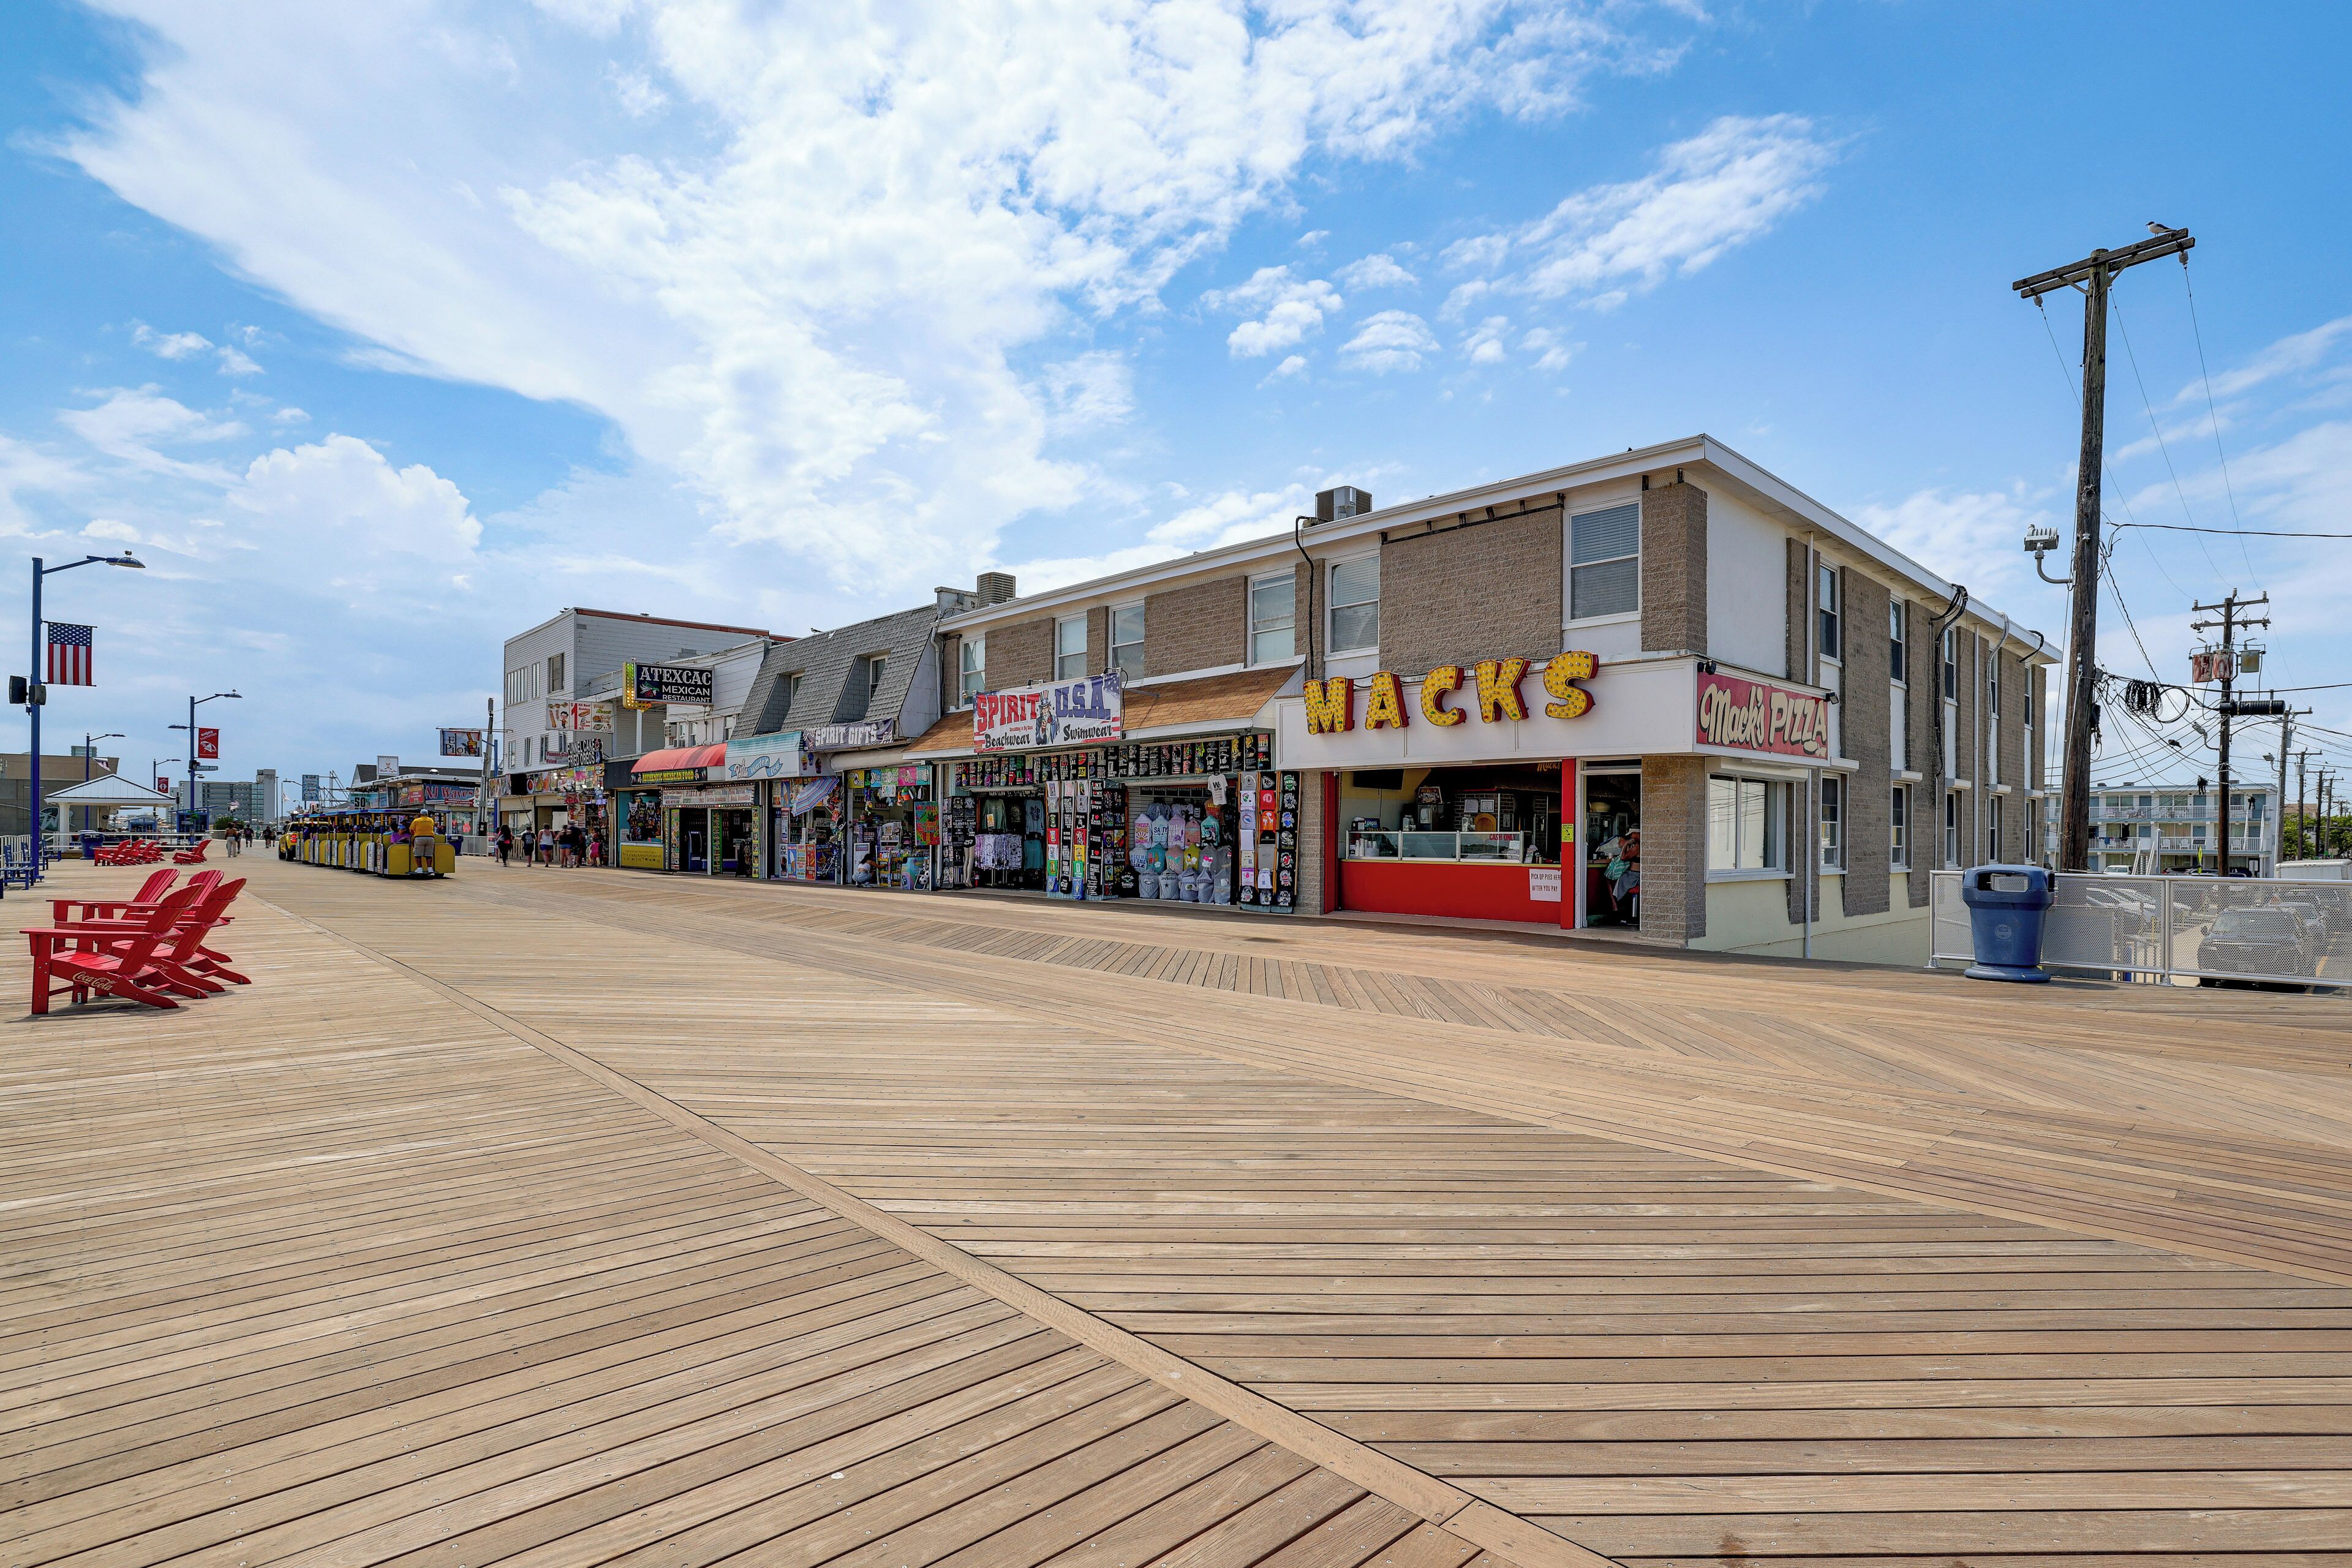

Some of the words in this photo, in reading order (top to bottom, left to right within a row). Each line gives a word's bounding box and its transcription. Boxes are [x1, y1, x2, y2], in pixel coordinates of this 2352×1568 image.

[639, 666, 711, 685] ATEXCAC
[662, 685, 710, 696] MEXICAN
[662, 694, 710, 703] RESTAURANT
[1304, 650, 1599, 735] MACKS
[978, 692, 1041, 733] SPIRIT
[1768, 692, 1827, 746] PIZZA
[815, 726, 846, 748] SPIRIT
[848, 723, 878, 745] GIFTS
[985, 733, 1030, 748] Beachwear
[1063, 724, 1112, 742] Swimwear
[568, 741, 582, 754] FUNNEL
[583, 739, 595, 752] CAKE
[568, 753, 579, 767] FRIED
[580, 751, 595, 766] OREOS
[643, 773, 662, 782] AUTHENTIC
[663, 771, 682, 781] MEXICAN
[682, 771, 694, 780] FOOD
[425, 786, 439, 799] NJ
[441, 786, 473, 799] Waves
